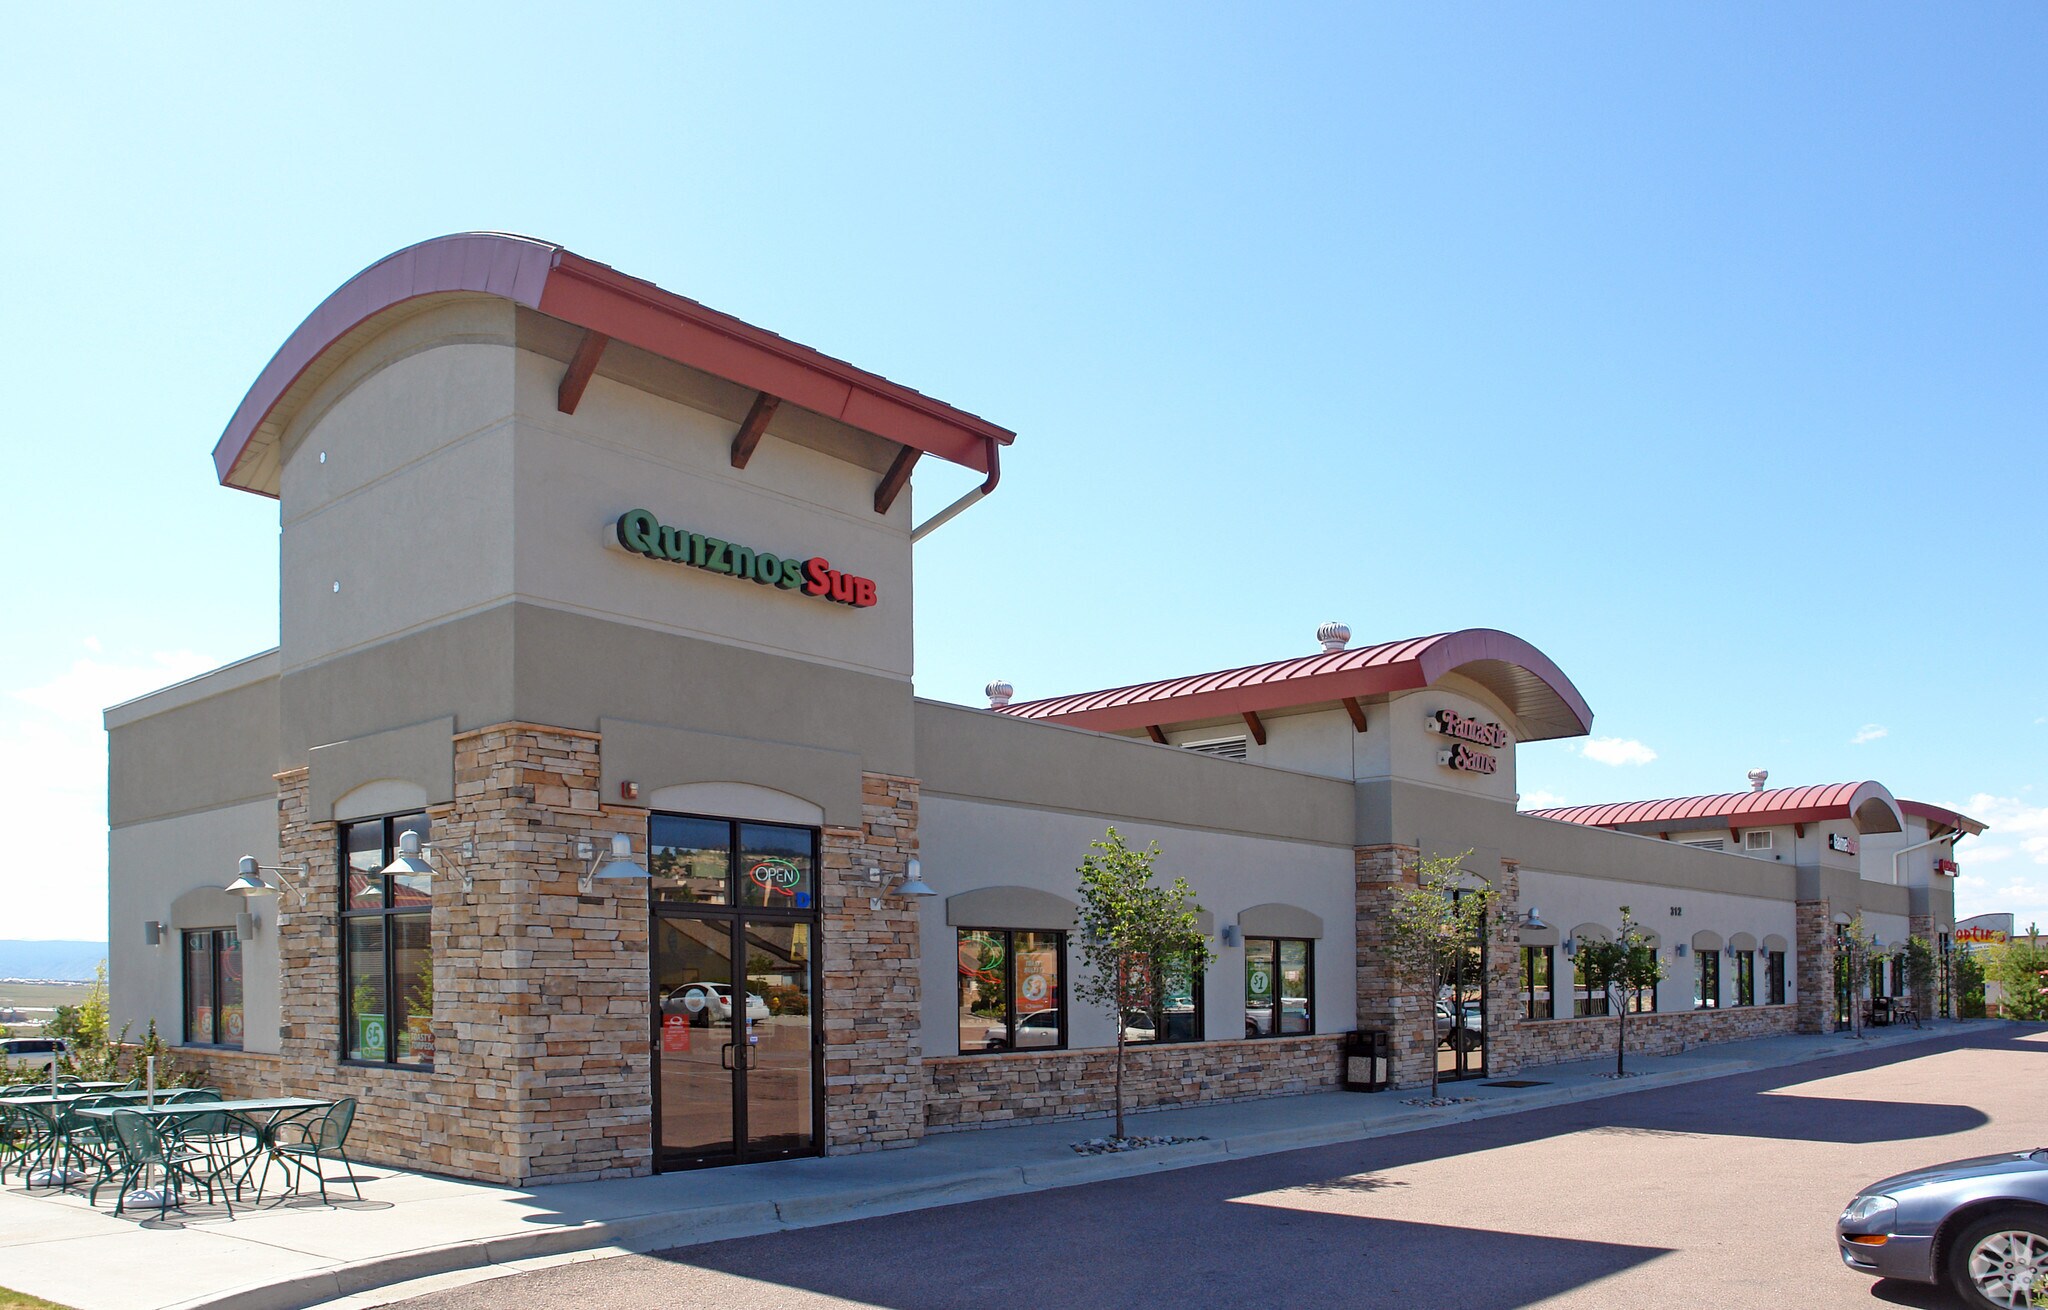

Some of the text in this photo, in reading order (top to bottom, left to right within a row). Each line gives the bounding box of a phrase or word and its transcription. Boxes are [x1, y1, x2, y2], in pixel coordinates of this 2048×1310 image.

[755, 866, 794, 883] OPEN
[1253, 974, 1265, 990] $1
[367, 1025, 381, 1047] $5
